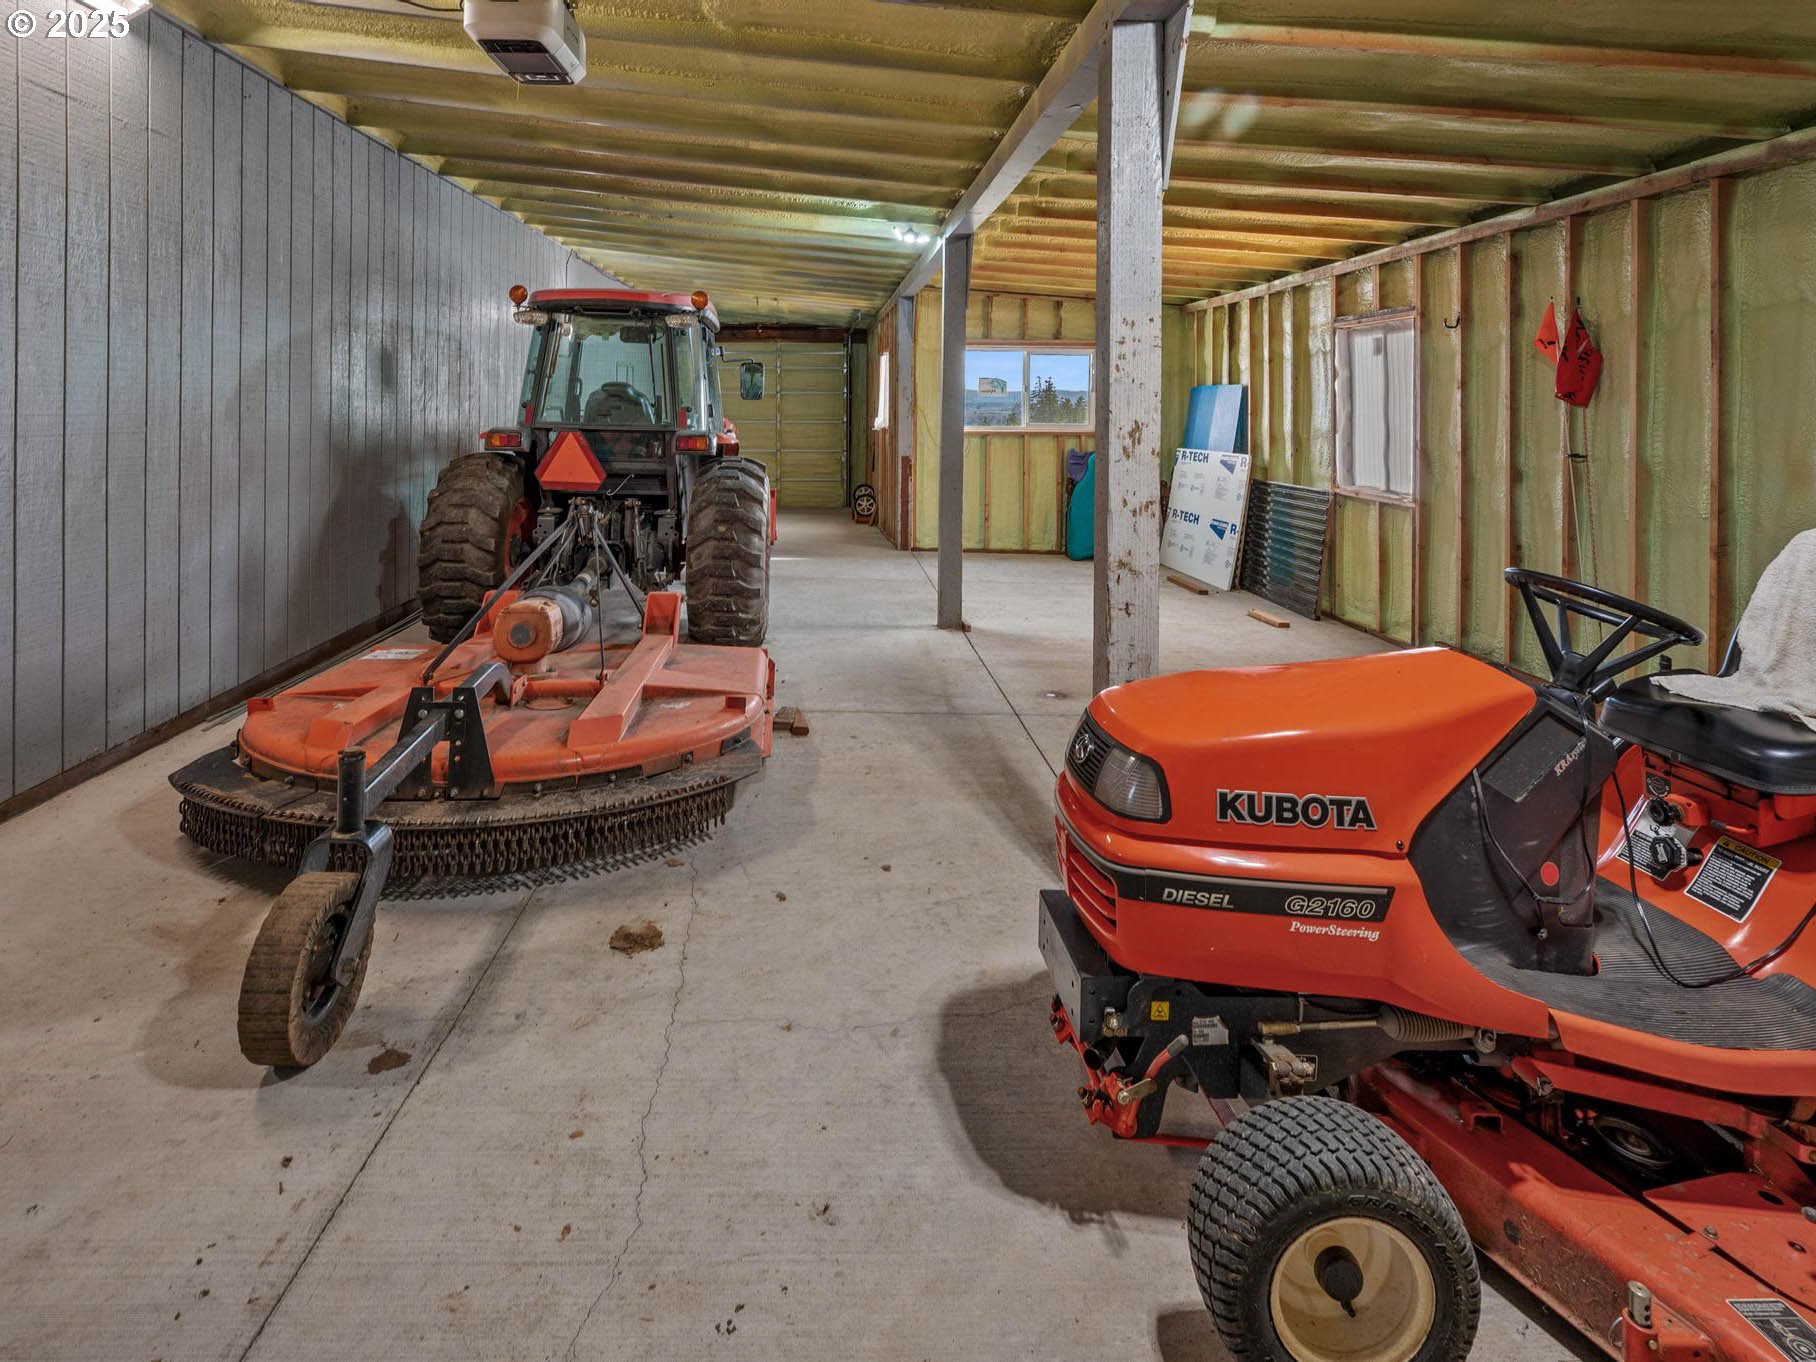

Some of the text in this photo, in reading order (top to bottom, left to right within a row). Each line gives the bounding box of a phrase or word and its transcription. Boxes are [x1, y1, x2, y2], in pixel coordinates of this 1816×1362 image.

[1216, 789, 1378, 831] KUBOTA
[1162, 887, 1376, 918] DIESEL G2160
[1289, 920, 1381, 942] PowerSteering
